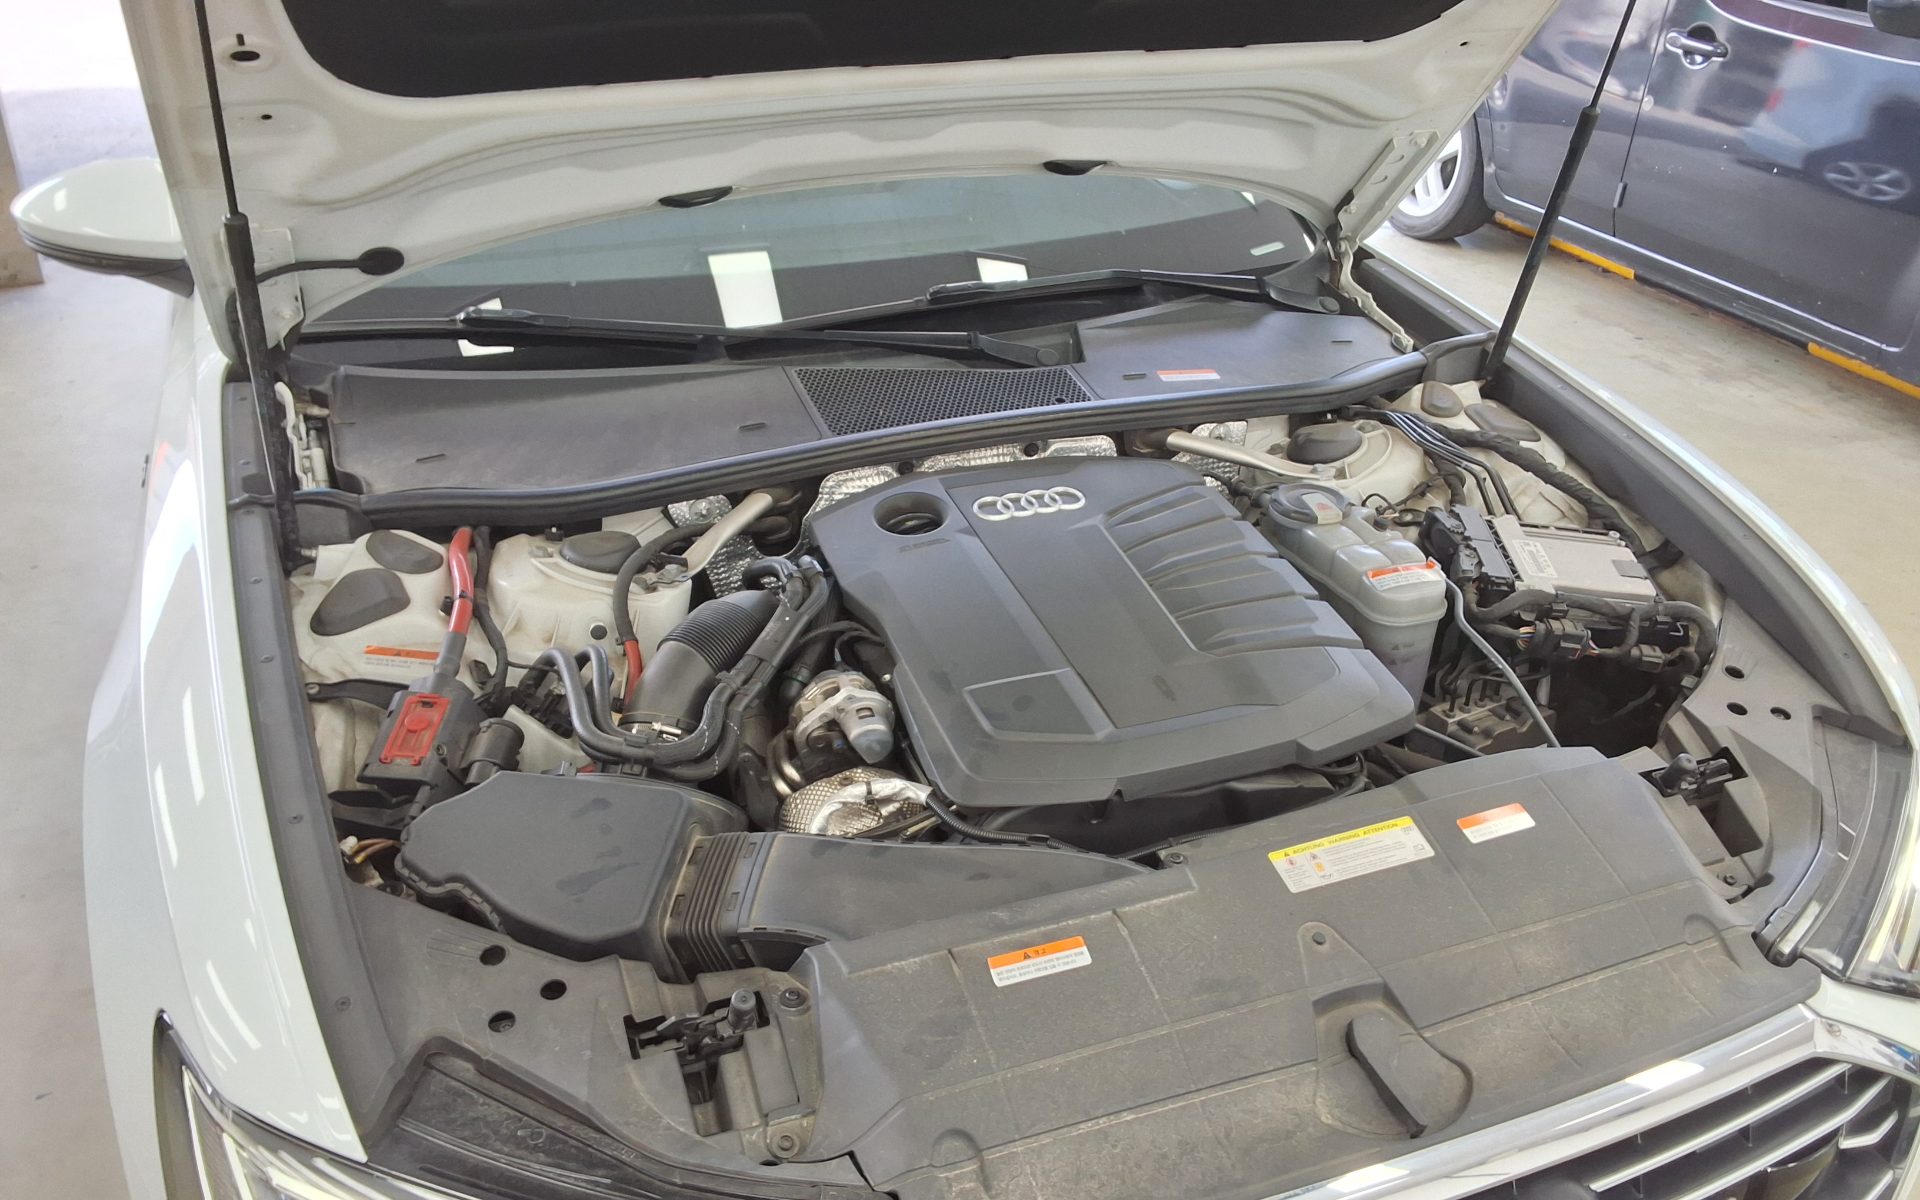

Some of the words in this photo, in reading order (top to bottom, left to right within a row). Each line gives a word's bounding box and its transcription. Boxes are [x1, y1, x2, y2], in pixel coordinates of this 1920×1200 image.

[1292, 842, 1325, 855] ACHTUNG
[1328, 832, 1360, 845] WARNING
[1363, 822, 1398, 836] ATTENTION
